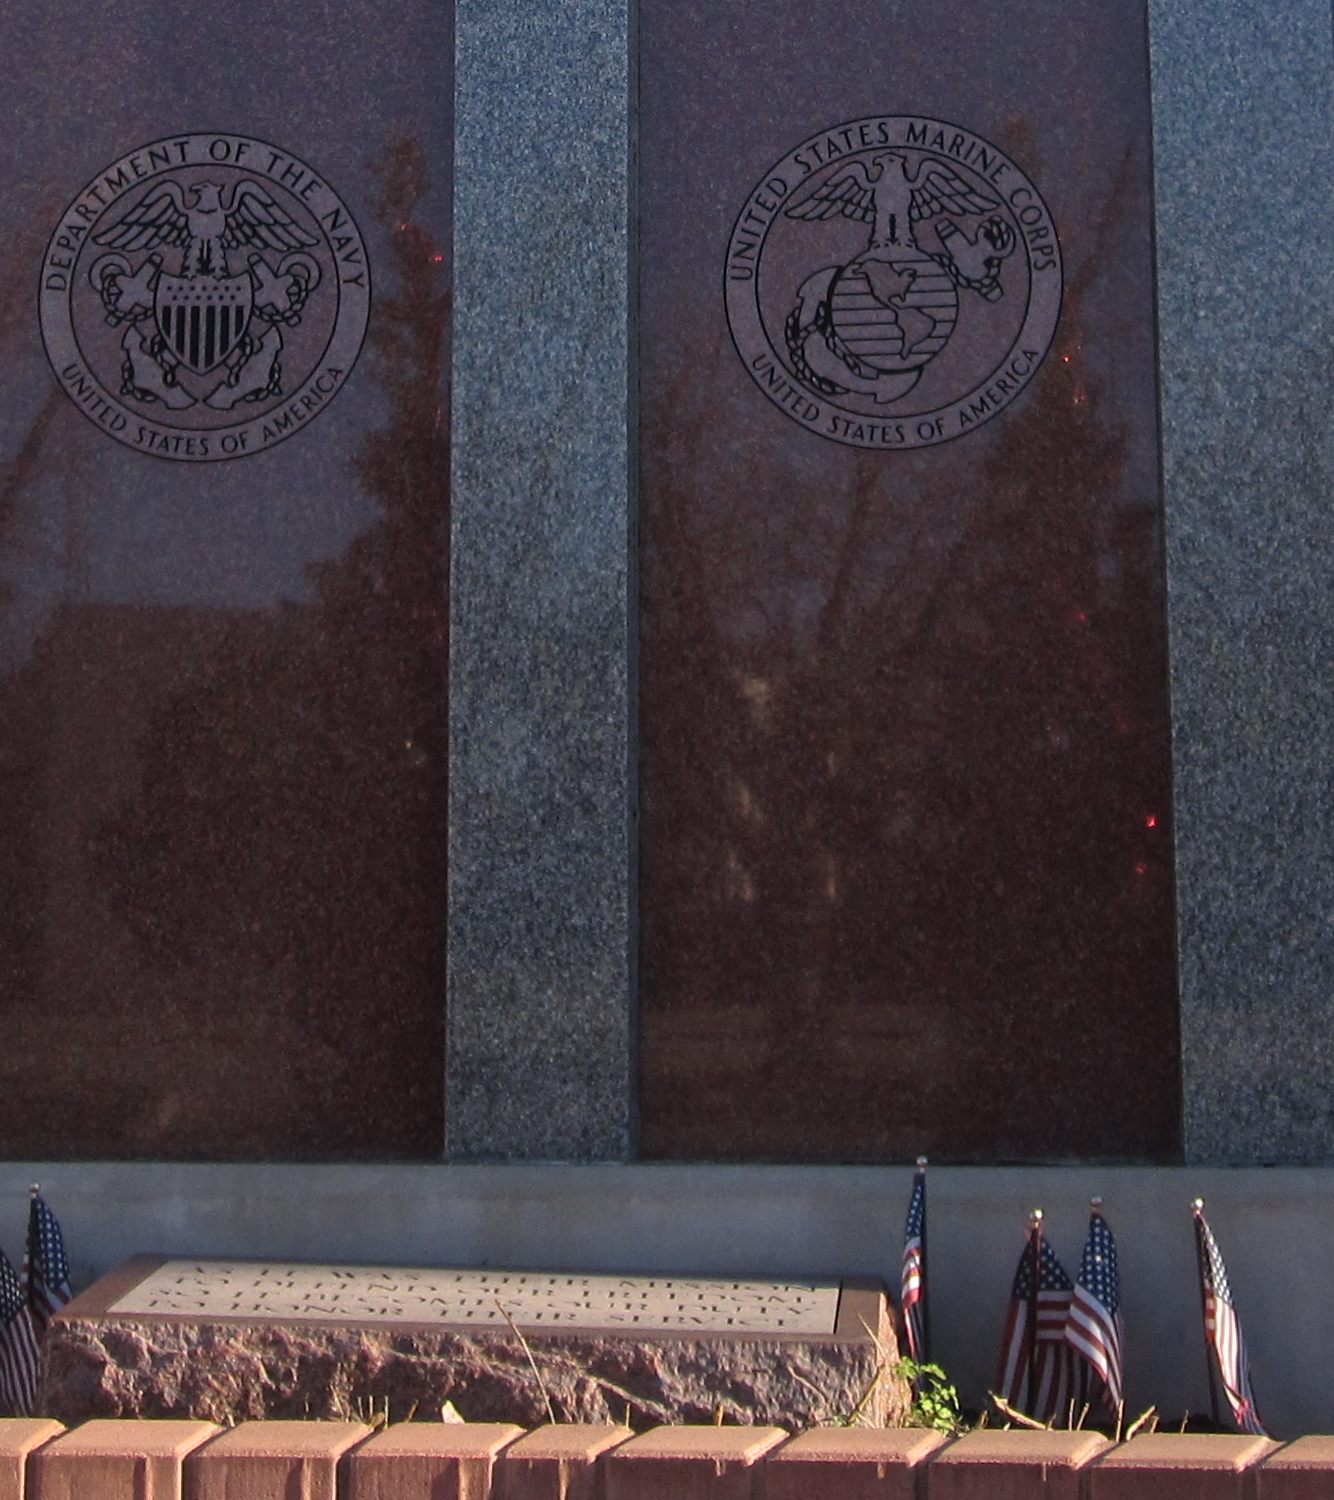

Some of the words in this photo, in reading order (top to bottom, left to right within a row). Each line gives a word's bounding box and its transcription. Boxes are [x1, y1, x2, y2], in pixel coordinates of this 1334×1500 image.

[45, 139, 192, 293] DEPARTMENT
[208, 138, 252, 165] OF
[266, 151, 322, 202] THE
[320, 205, 366, 289] NAVY
[728, 176, 790, 282] UNITED
[793, 122, 890, 176] STATES
[905, 122, 1011, 183] MARINE
[1008, 186, 1058, 273] CORPS
[60, 362, 128, 434] UNITED
[132, 424, 210, 457] STATES
[219, 430, 251, 455] OF
[261, 365, 345, 443] AMERICA
[751, 353, 821, 425] UNITED
[826, 414, 906, 446] STATES
[916, 418, 947, 442] OF
[957, 347, 1040, 430] AMERICA
